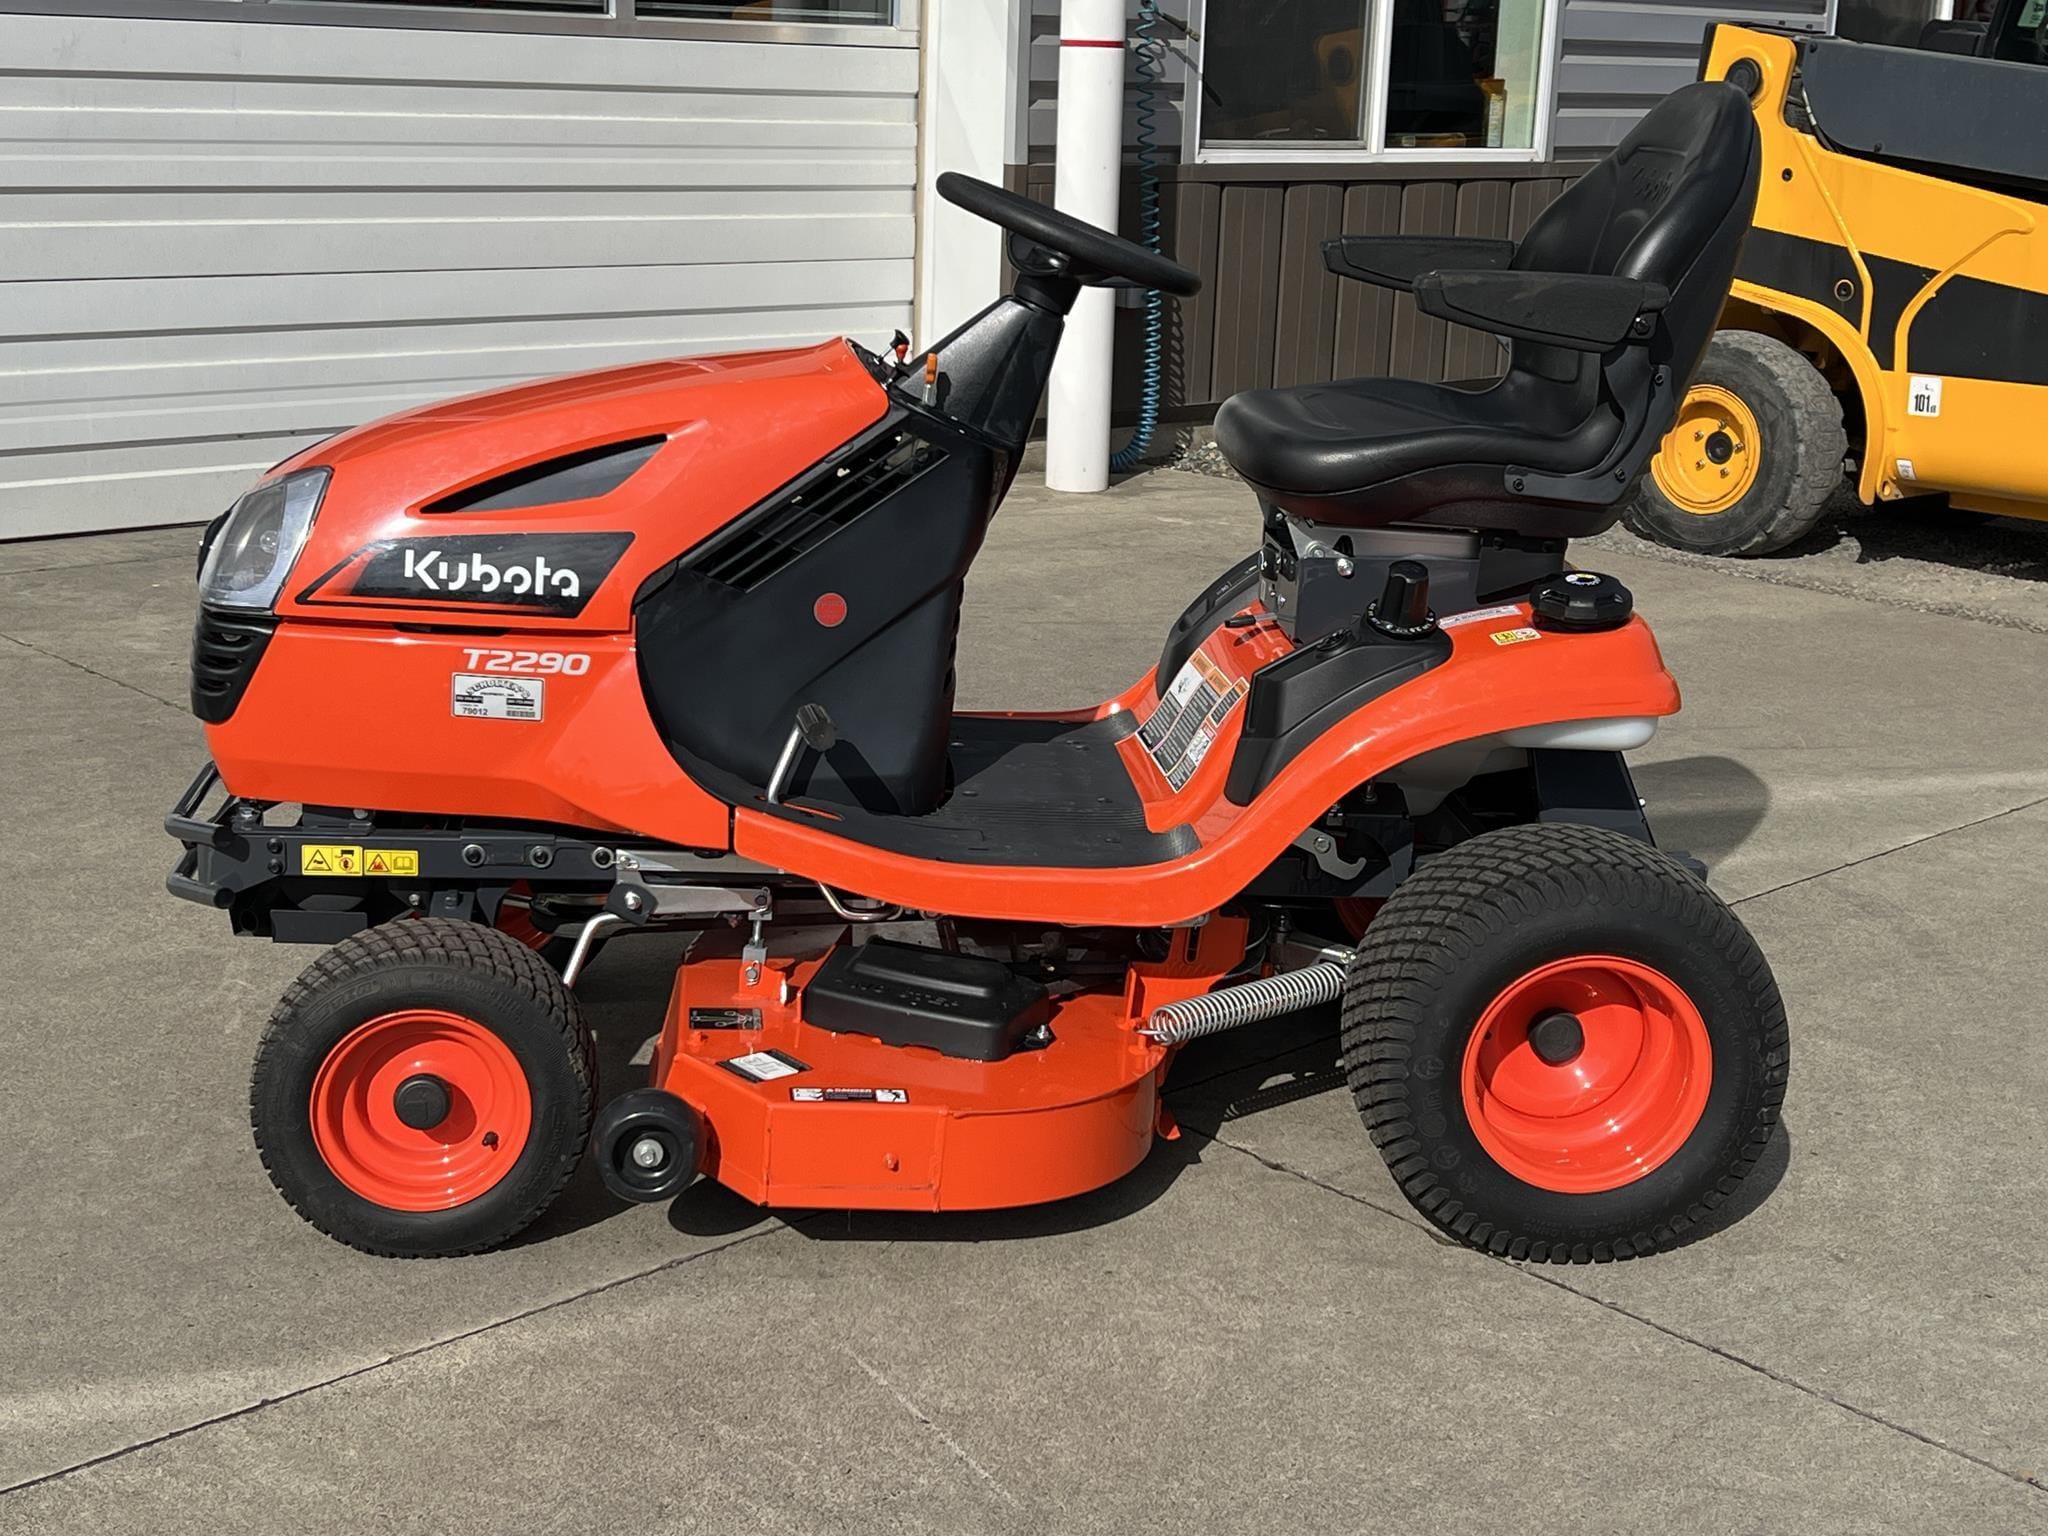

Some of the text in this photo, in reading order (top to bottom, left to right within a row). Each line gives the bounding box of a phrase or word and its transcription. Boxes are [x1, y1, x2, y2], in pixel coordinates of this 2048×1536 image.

[1914, 393, 1930, 413] 101
[404, 549, 580, 597] Kubota
[462, 648, 591, 676] T2290
[462, 707, 488, 716] 79012
